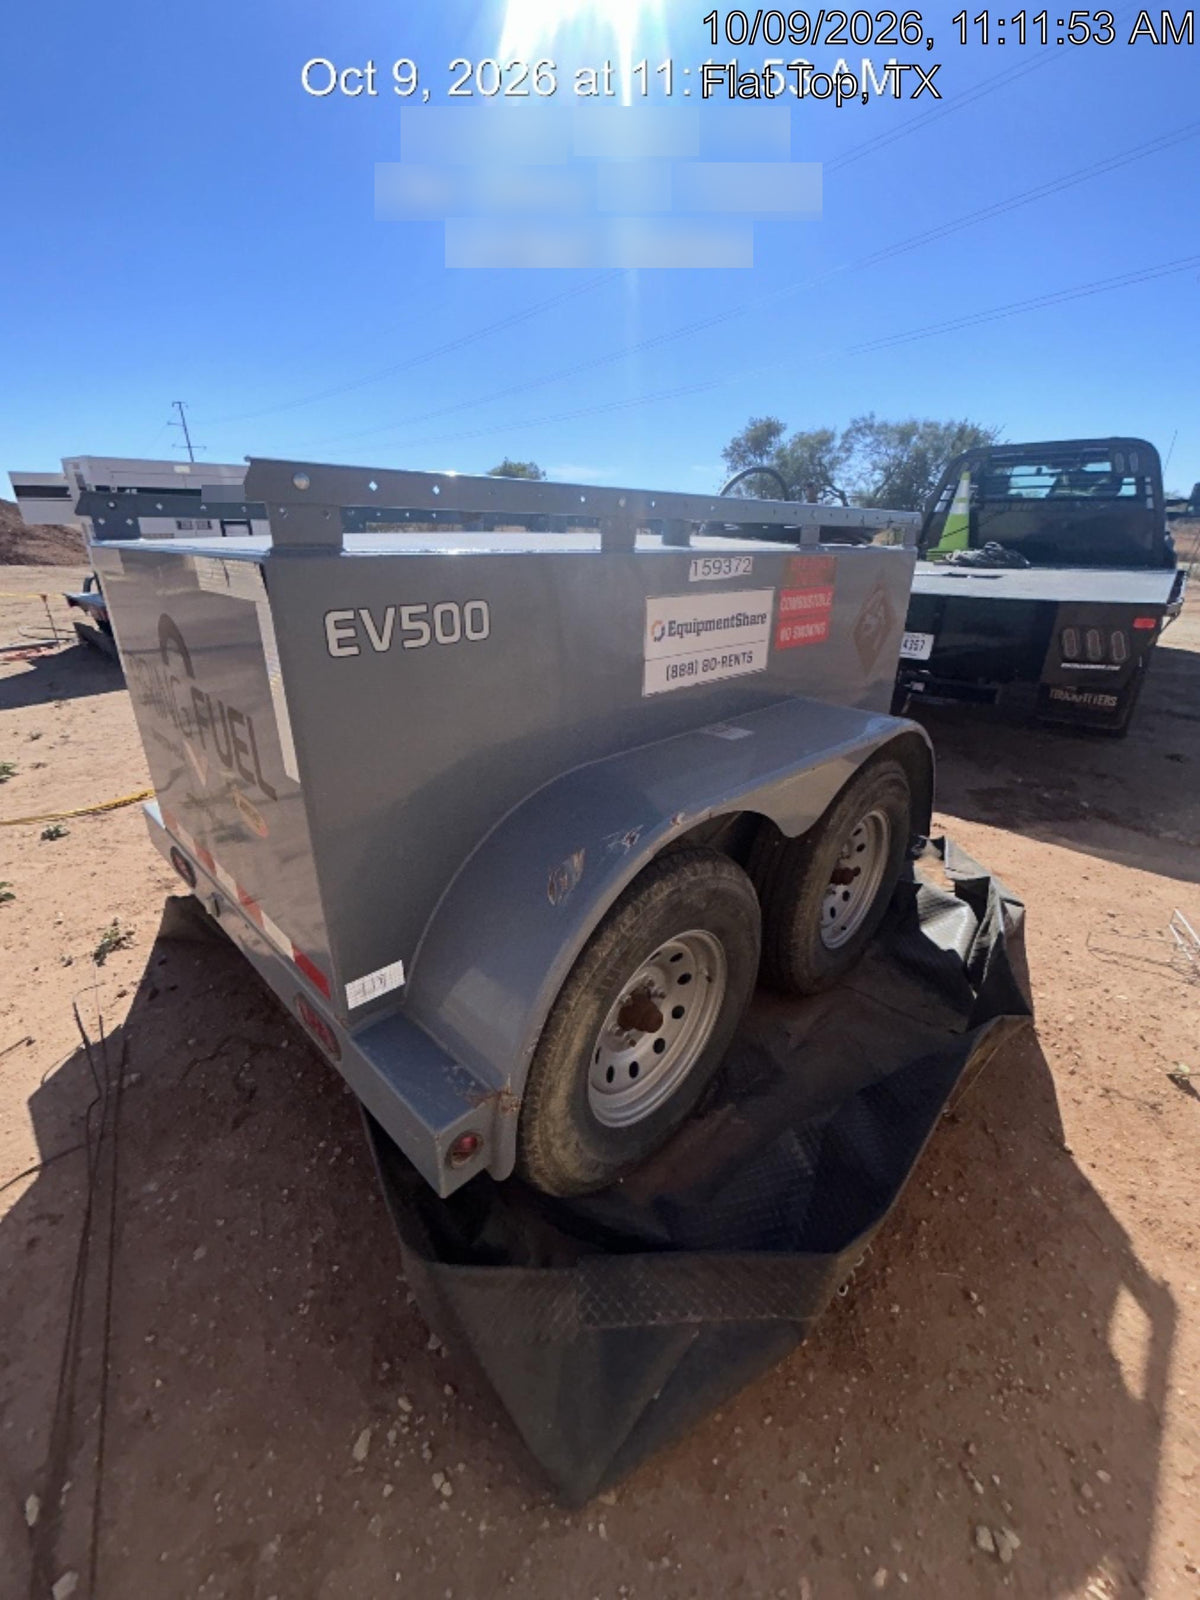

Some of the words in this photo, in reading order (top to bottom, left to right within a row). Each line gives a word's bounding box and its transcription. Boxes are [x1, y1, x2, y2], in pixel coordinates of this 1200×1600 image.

[693, 557, 752, 577] 159372
[324, 598, 491, 658] EV500
[668, 611, 768, 639] EquipmentShare
[666, 659, 698, 681] (888)
